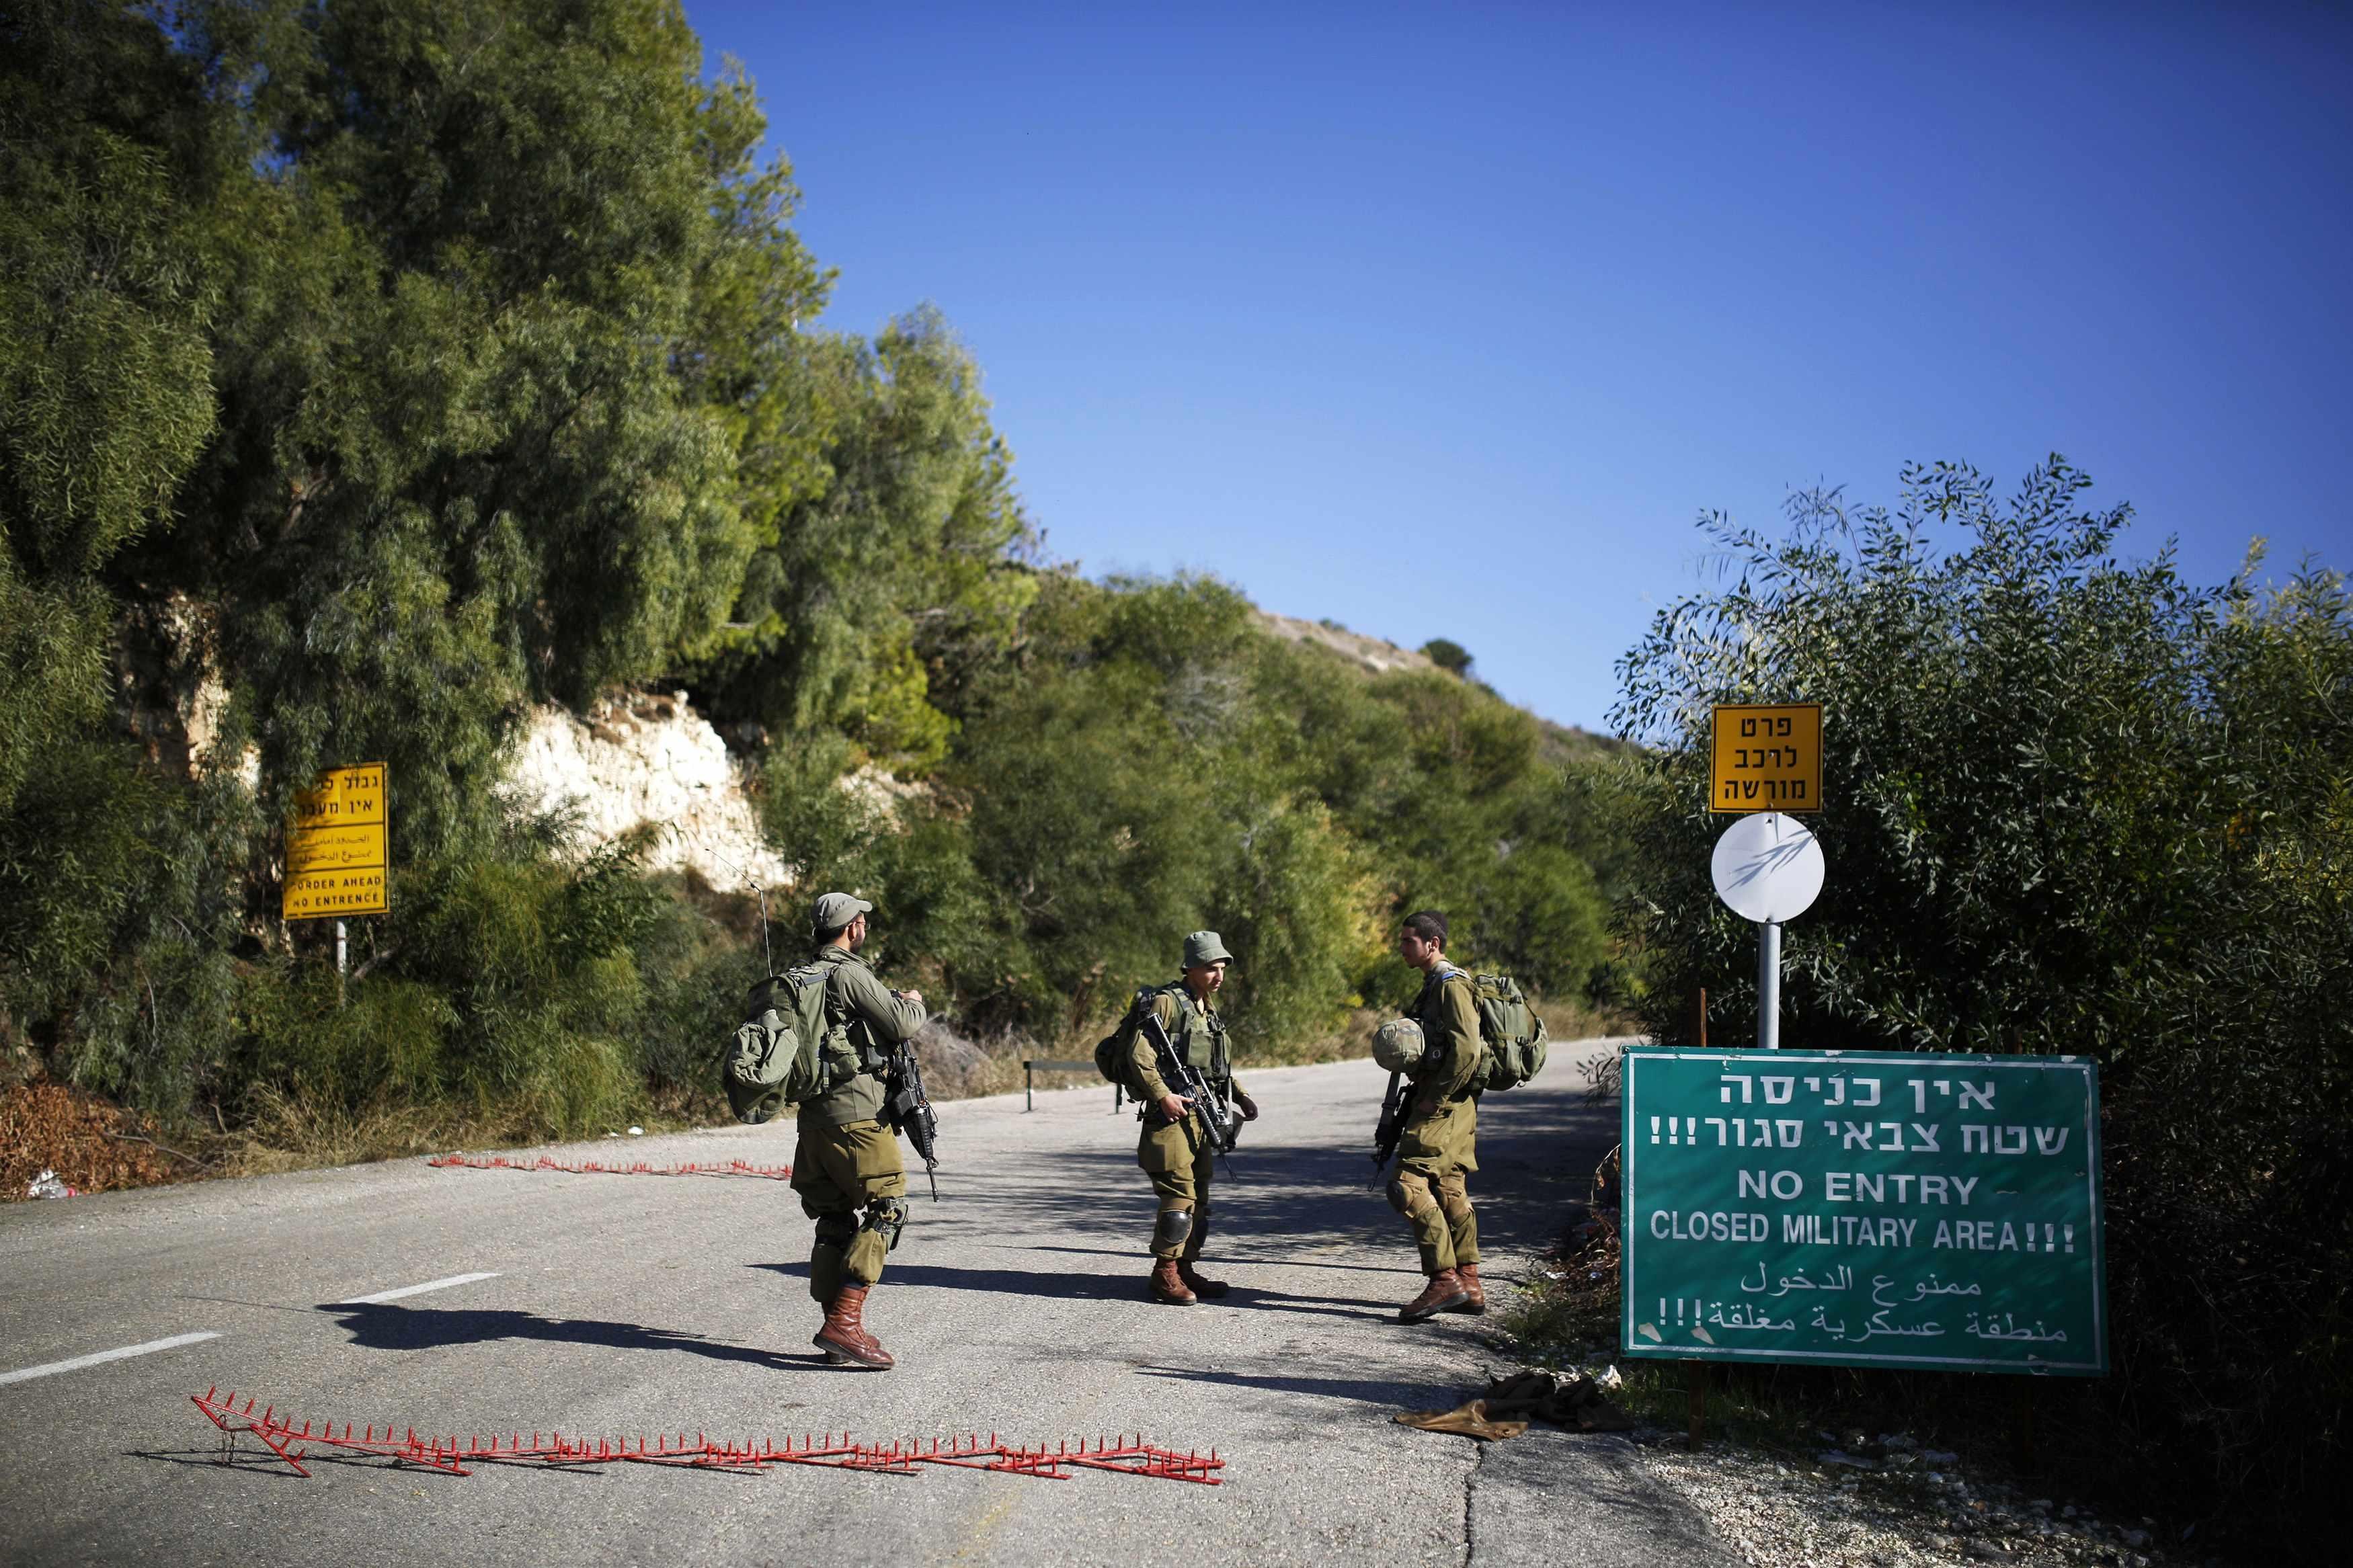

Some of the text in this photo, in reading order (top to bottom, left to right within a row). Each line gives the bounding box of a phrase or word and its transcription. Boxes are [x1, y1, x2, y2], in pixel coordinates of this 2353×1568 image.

[1741, 717, 1792, 737] פרט
[1734, 745, 1797, 768] לרכב
[344, 774, 378, 789] גבול
[1724, 780, 1806, 799] מורשה
[350, 800, 372, 814] אין
[292, 876, 381, 891] ORDER AHEAD
[293, 893, 378, 908] NO ENTRENCE
[1721, 1075, 1994, 1113] אין כניסה
[1825, 1121, 1939, 1151] צבאי
[1961, 1125, 2068, 1153] שטח
[1739, 1170, 1978, 1204] NO ENTRY
[1651, 1210, 2073, 1251] CLOSED MILITARY AREA!!!
[1741, 1262, 1852, 1296] الدخول
[1965, 1311, 2067, 1342] منطقة
